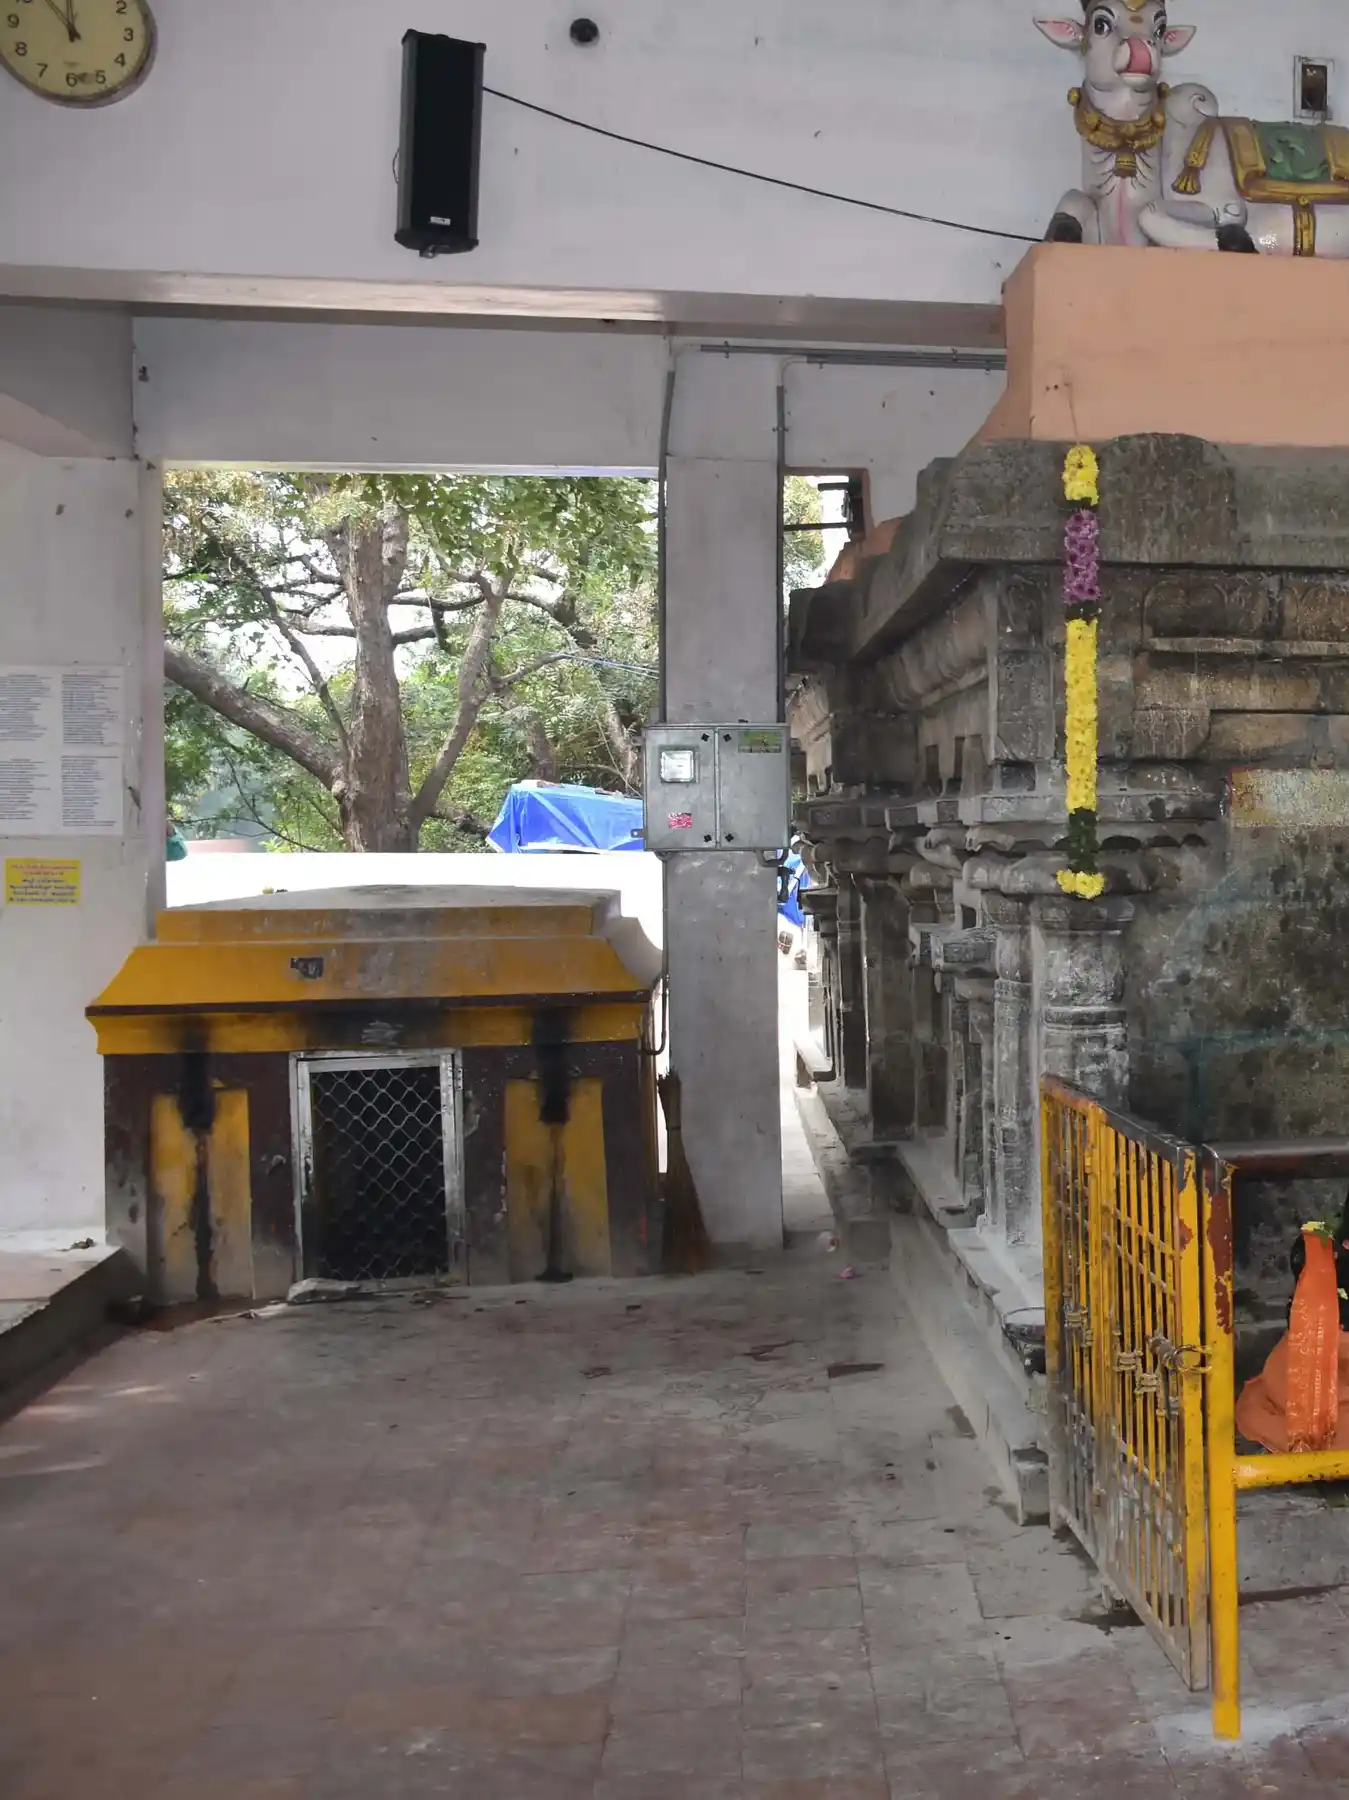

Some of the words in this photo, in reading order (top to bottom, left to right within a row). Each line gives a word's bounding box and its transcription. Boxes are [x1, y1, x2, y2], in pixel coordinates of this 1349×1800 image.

[115, 0, 127, 14] 2
[7, 14, 20, 28] 9
[123, 27, 134, 41] 3
[15, 42, 27, 56] 8
[114, 52, 126, 67] 4
[36, 63, 48, 78] 7
[95, 70, 106, 84] 5
[65, 73, 78, 87] 6
